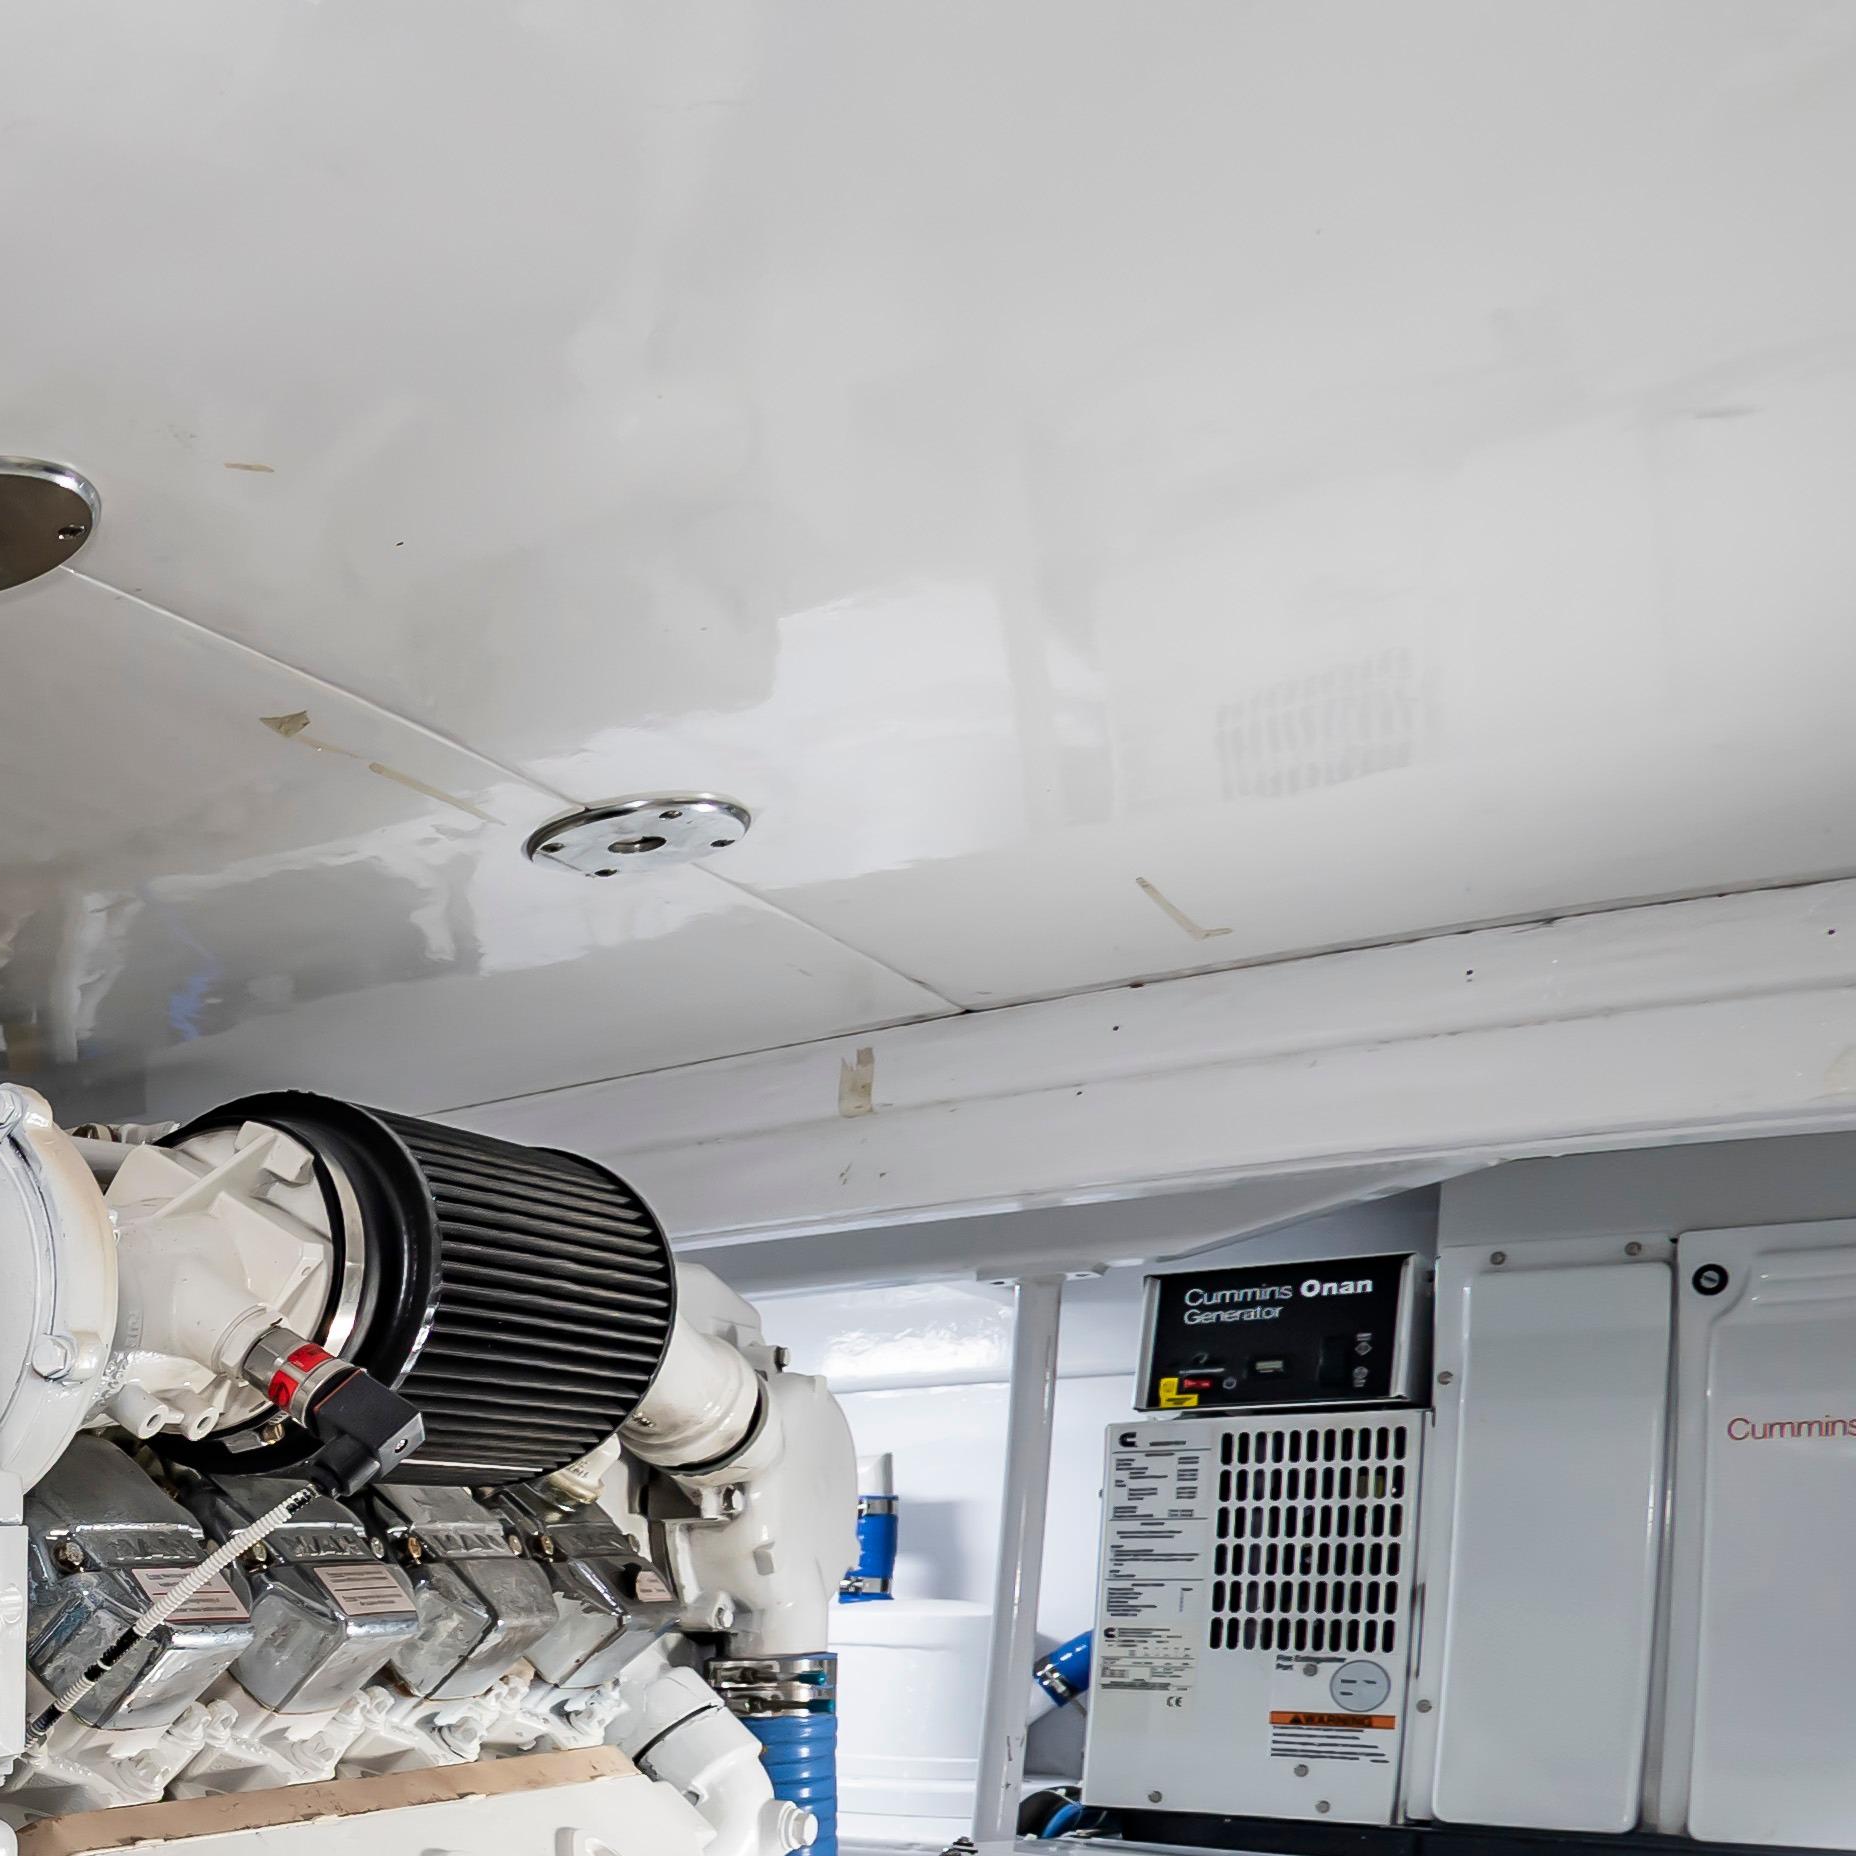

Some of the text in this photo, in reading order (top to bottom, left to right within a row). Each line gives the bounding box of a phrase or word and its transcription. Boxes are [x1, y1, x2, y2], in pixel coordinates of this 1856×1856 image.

[1184, 1278, 1373, 1306] Cummins Onan
[1183, 1305, 1284, 1325] Generator
